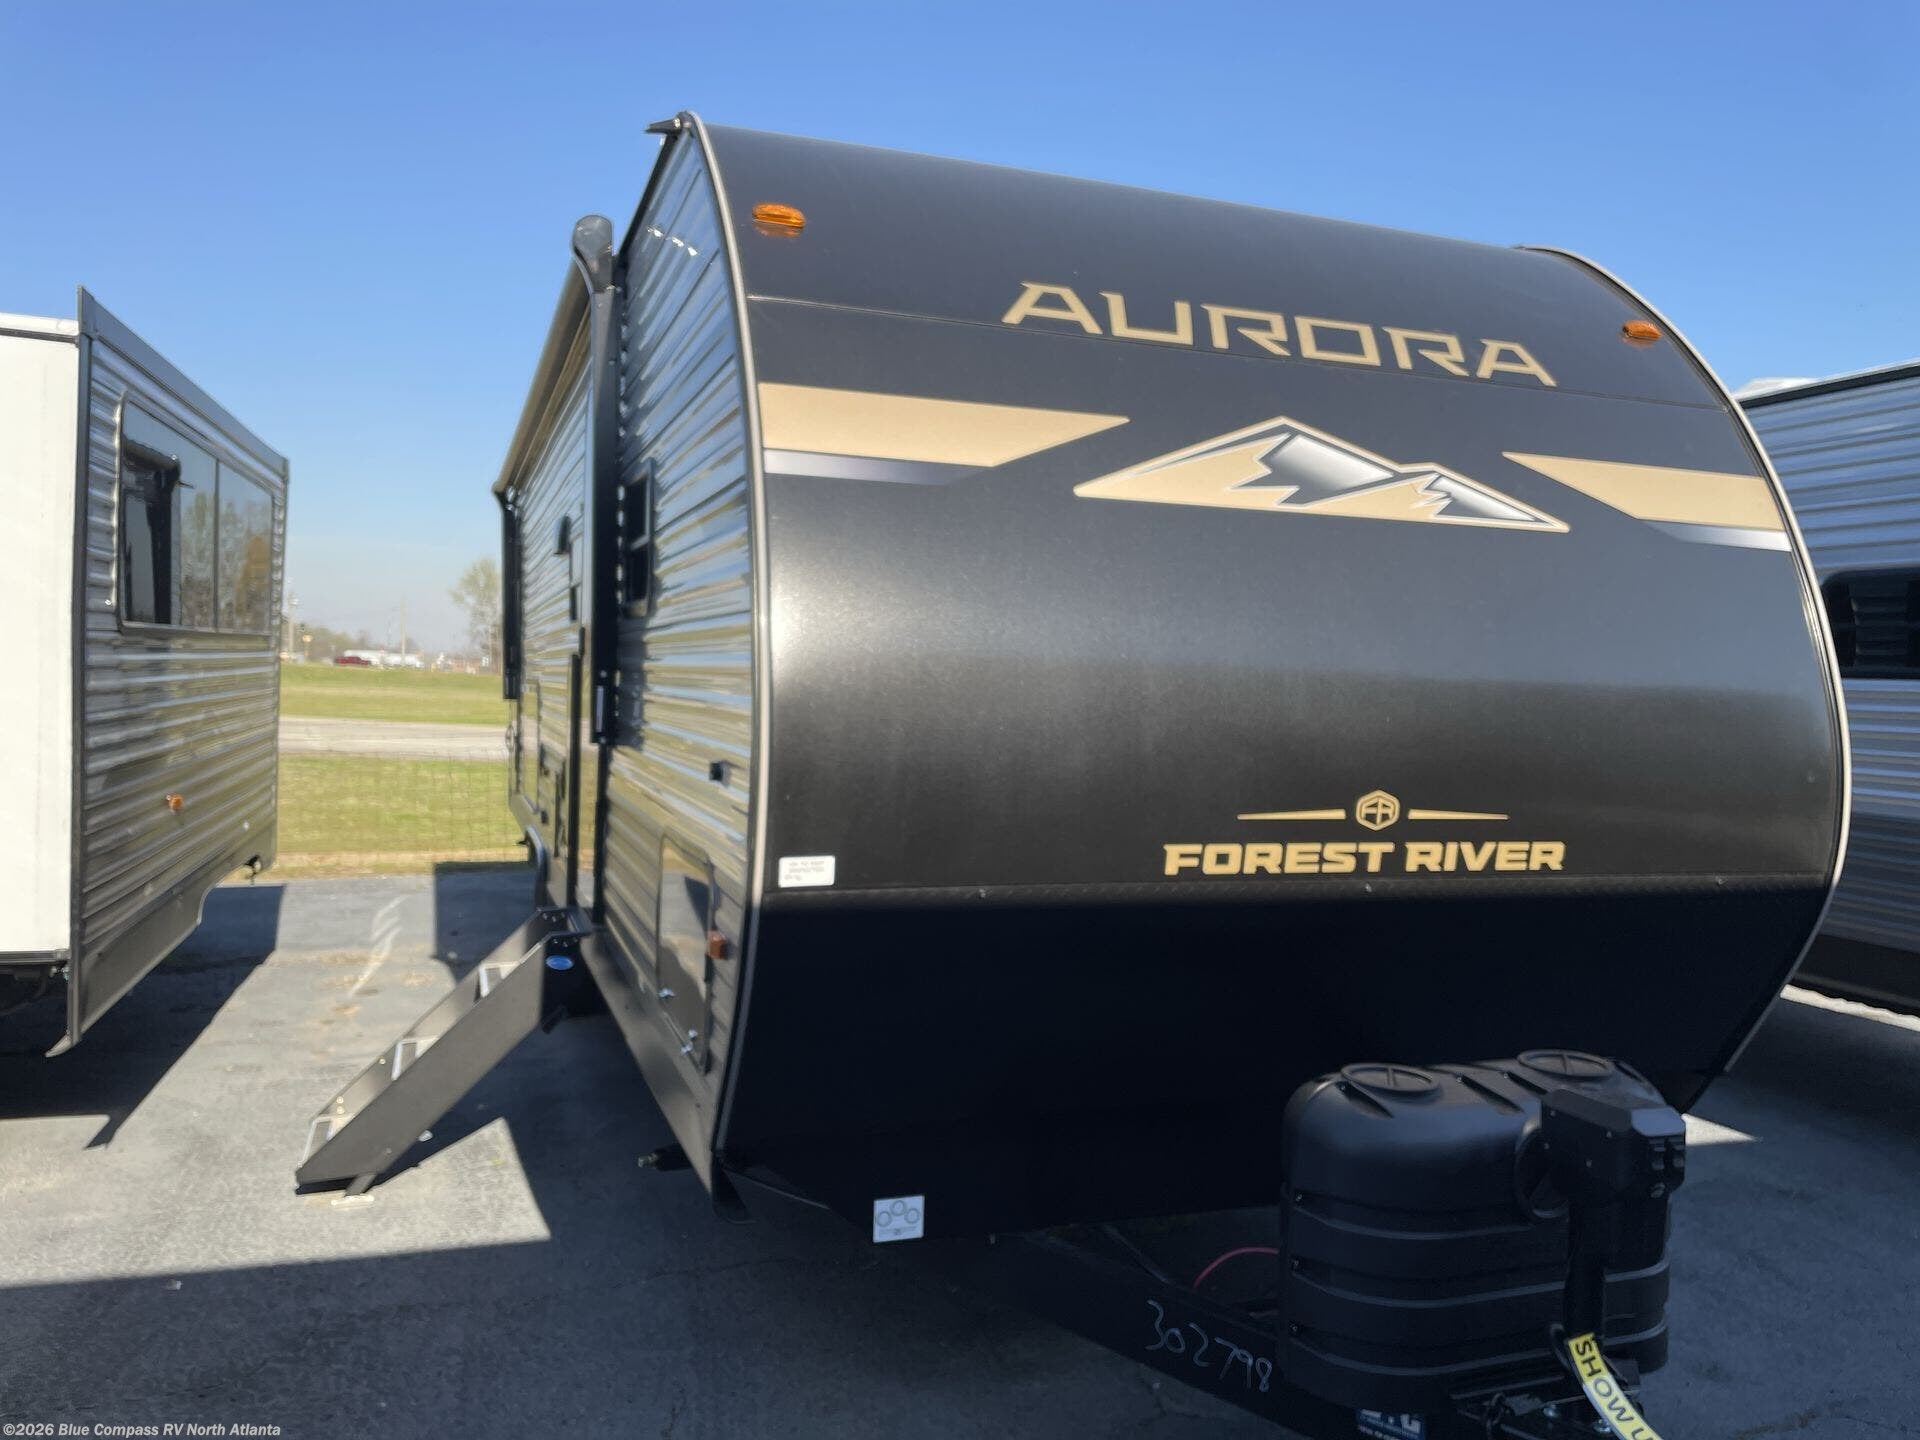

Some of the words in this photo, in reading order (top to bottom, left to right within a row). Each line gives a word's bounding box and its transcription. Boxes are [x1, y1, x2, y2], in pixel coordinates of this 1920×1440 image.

[1001, 281, 1558, 387] AURORA
[1163, 842, 1395, 876] FOREST
[1405, 841, 1567, 873] RIVER
[1145, 1299, 1272, 1392] 302798
[1575, 1340, 1634, 1422] SHOW
